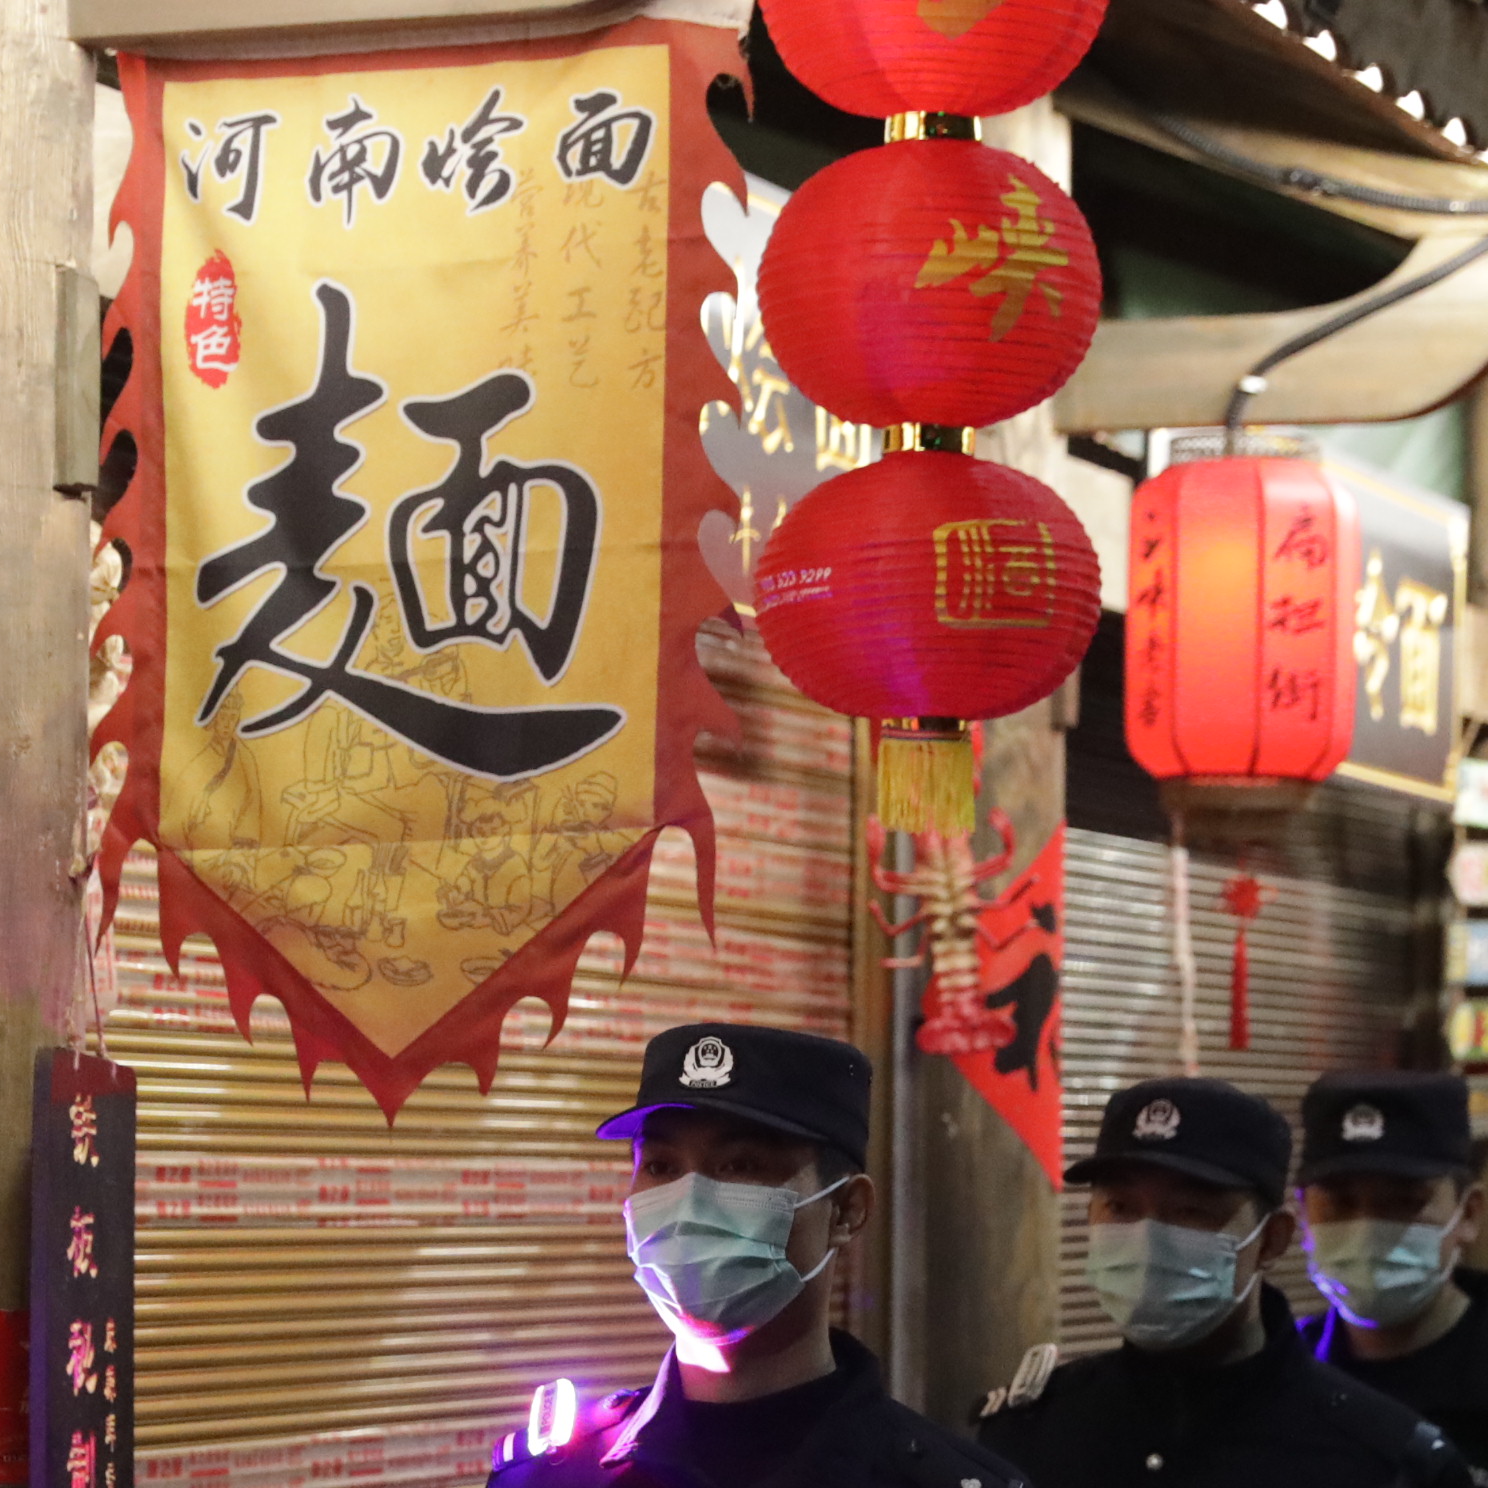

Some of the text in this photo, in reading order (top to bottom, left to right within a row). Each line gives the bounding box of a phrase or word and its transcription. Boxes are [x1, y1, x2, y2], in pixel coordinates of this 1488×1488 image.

[181, 88, 654, 226] 河南烩面
[191, 277, 238, 372] 特色
